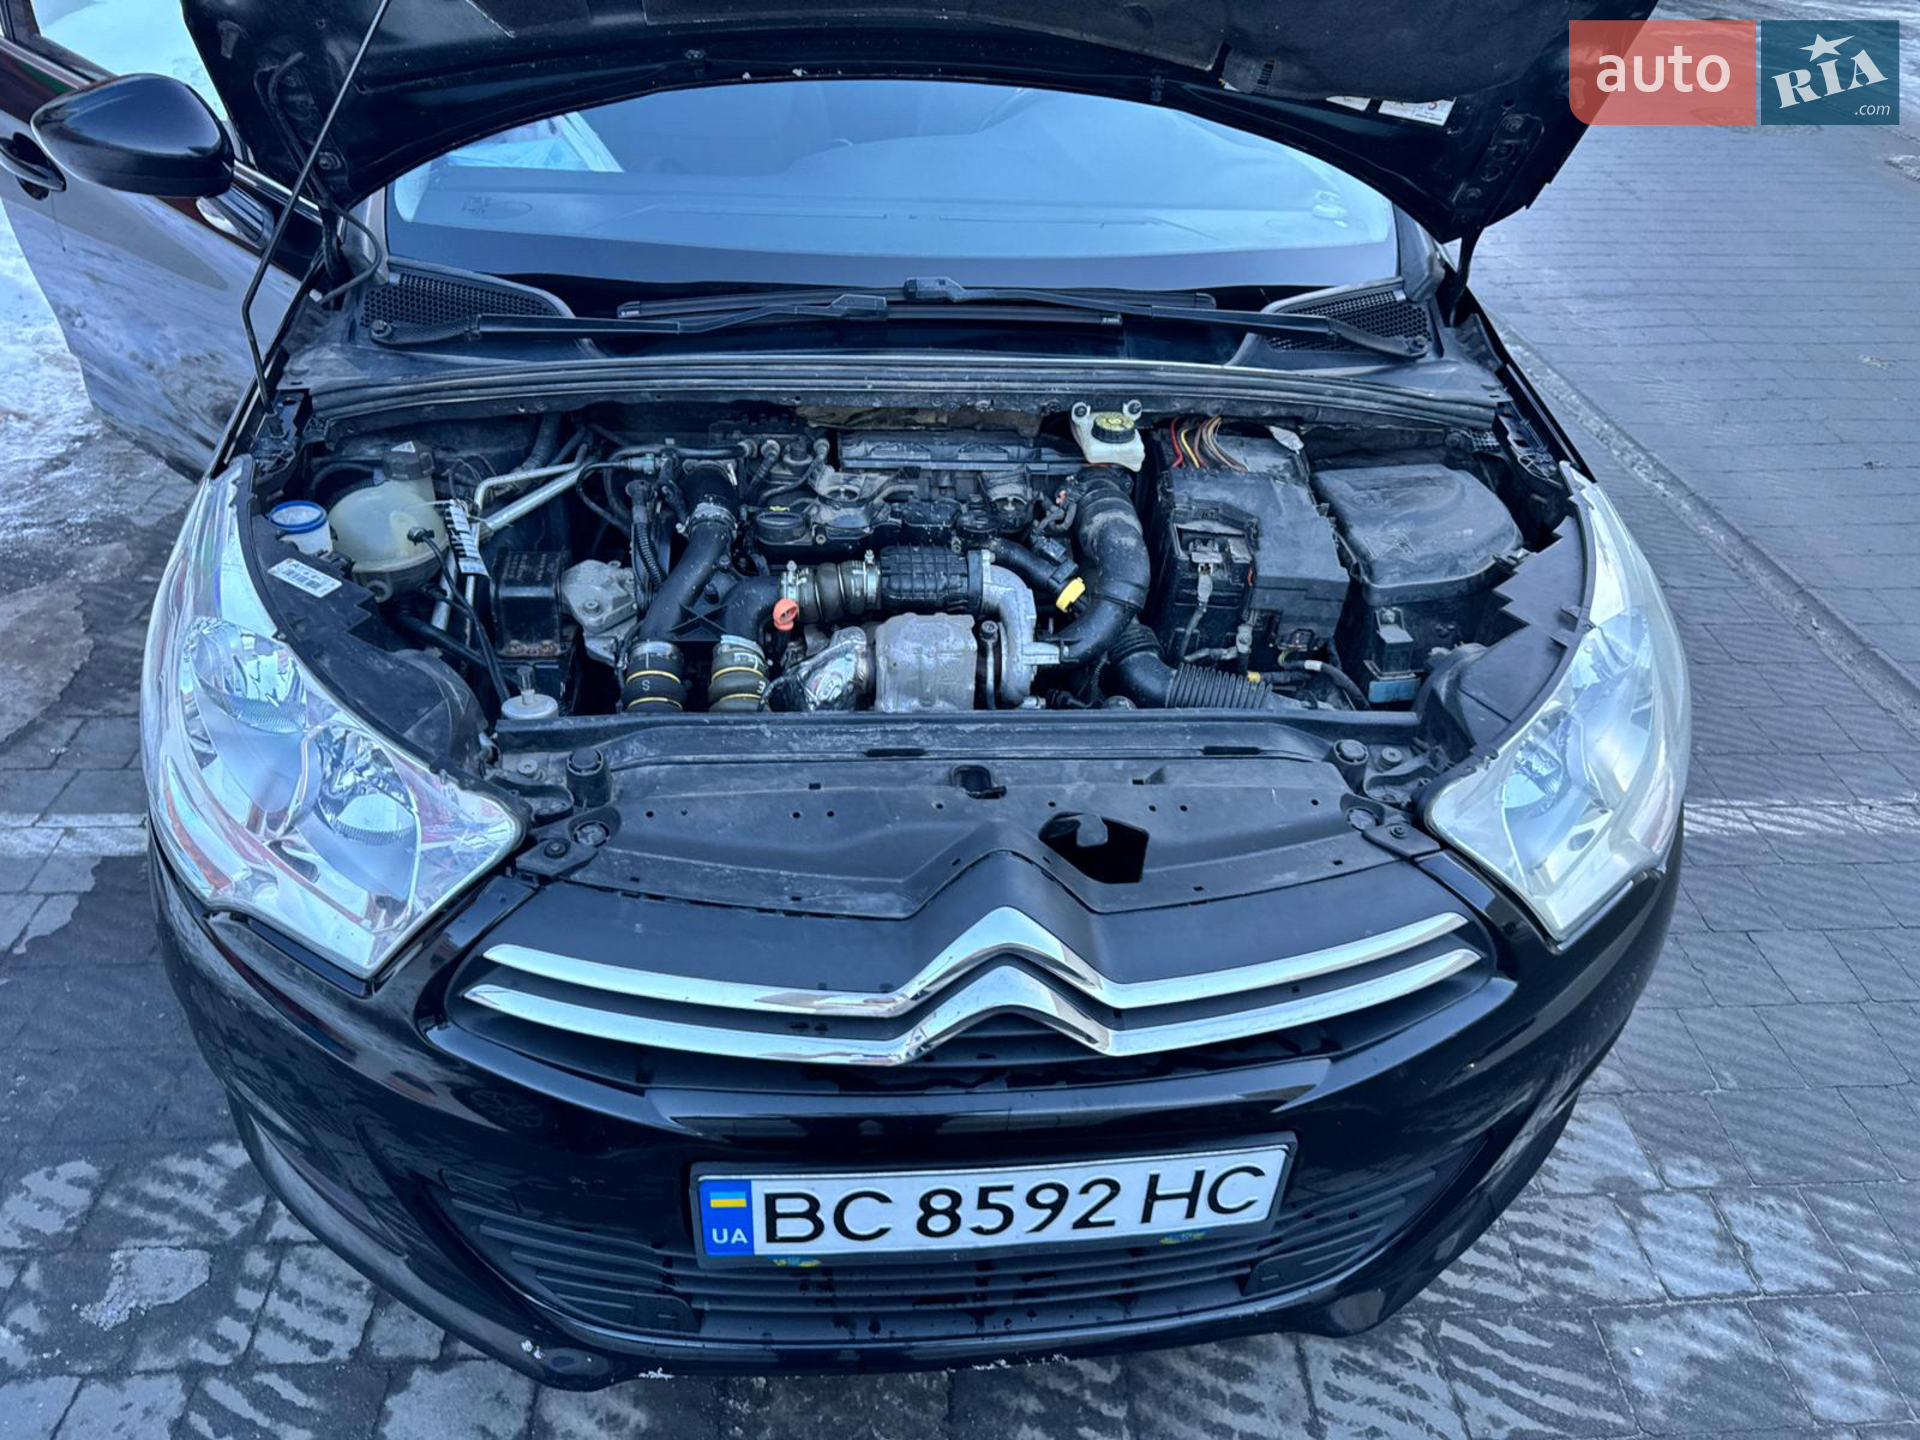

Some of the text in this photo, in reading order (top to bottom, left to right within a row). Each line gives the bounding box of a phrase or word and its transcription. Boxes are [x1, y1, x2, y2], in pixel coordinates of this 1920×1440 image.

[641, 680, 651, 691] S
[764, 1165, 1266, 1244] BC 8592 HC
[712, 1229, 747, 1245] UA
